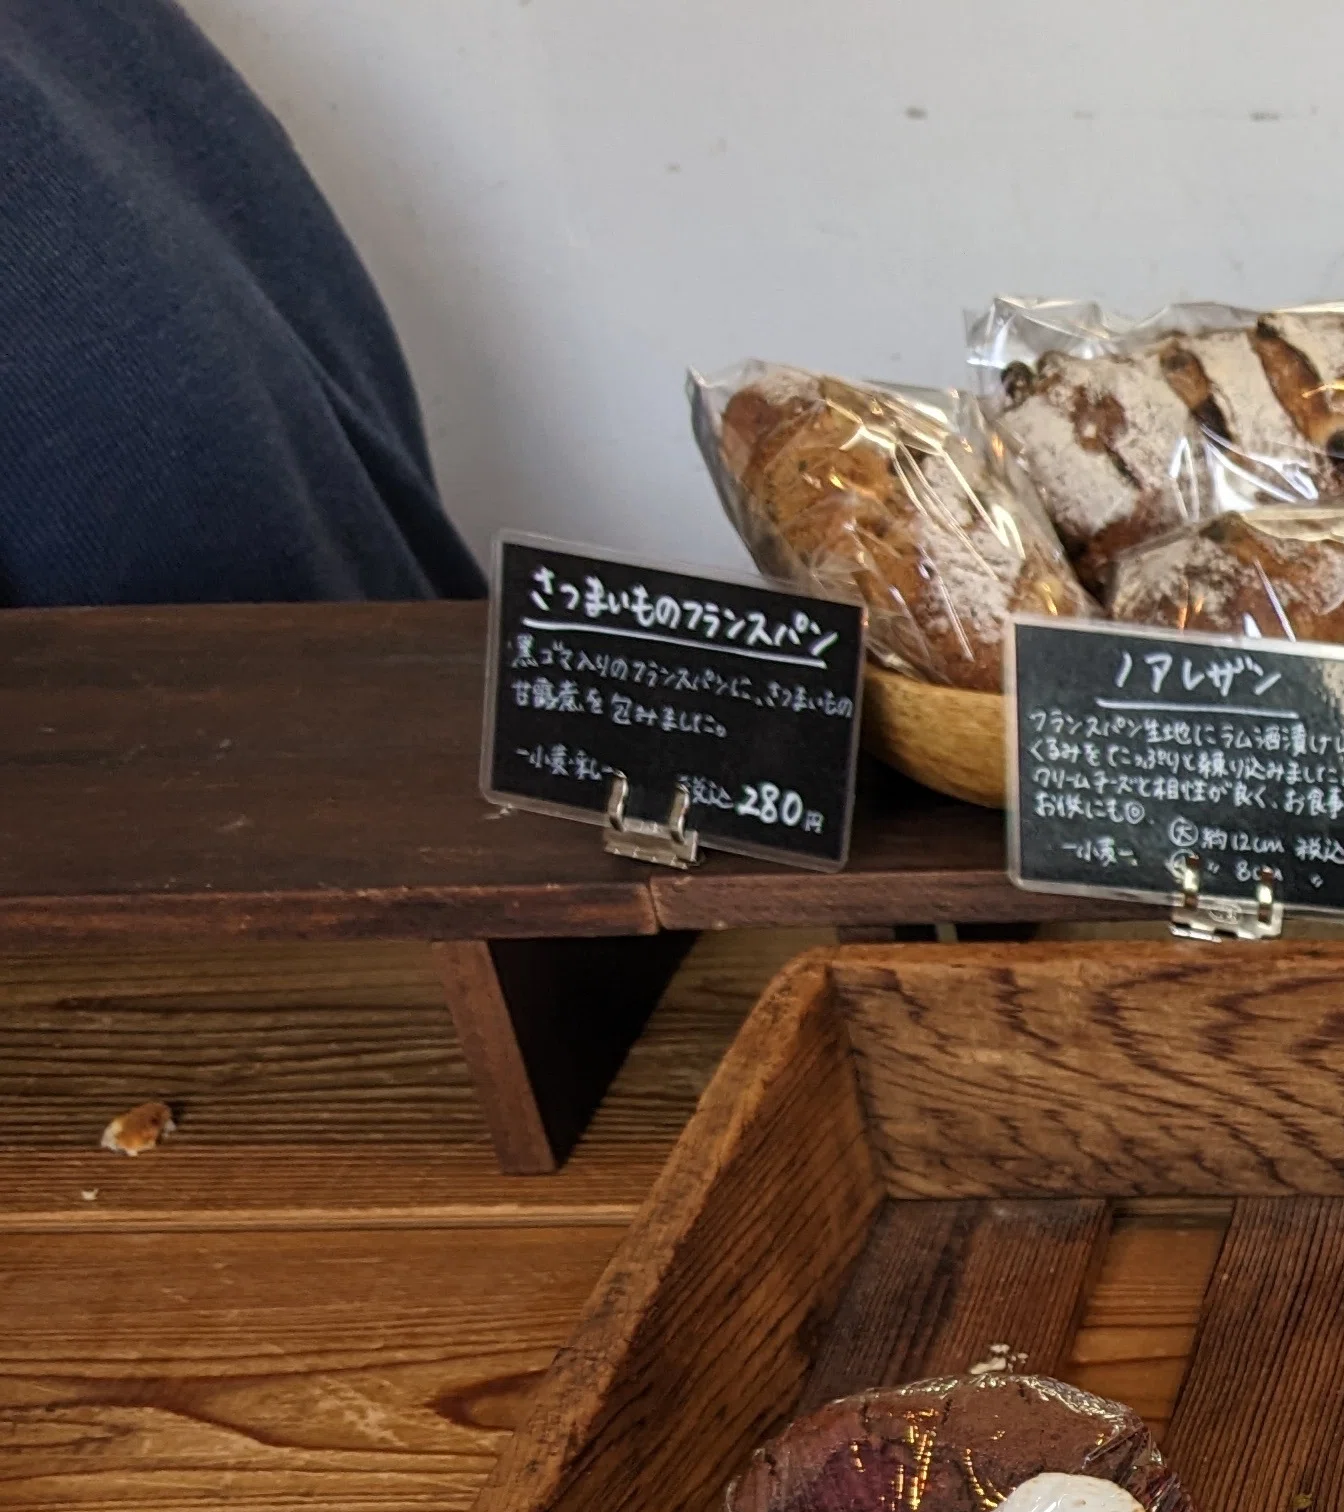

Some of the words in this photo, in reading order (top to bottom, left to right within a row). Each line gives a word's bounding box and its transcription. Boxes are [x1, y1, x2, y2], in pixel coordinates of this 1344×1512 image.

[529, 566, 838, 656] さつまいものフランスパン
[1115, 652, 1282, 696] ノアレザン
